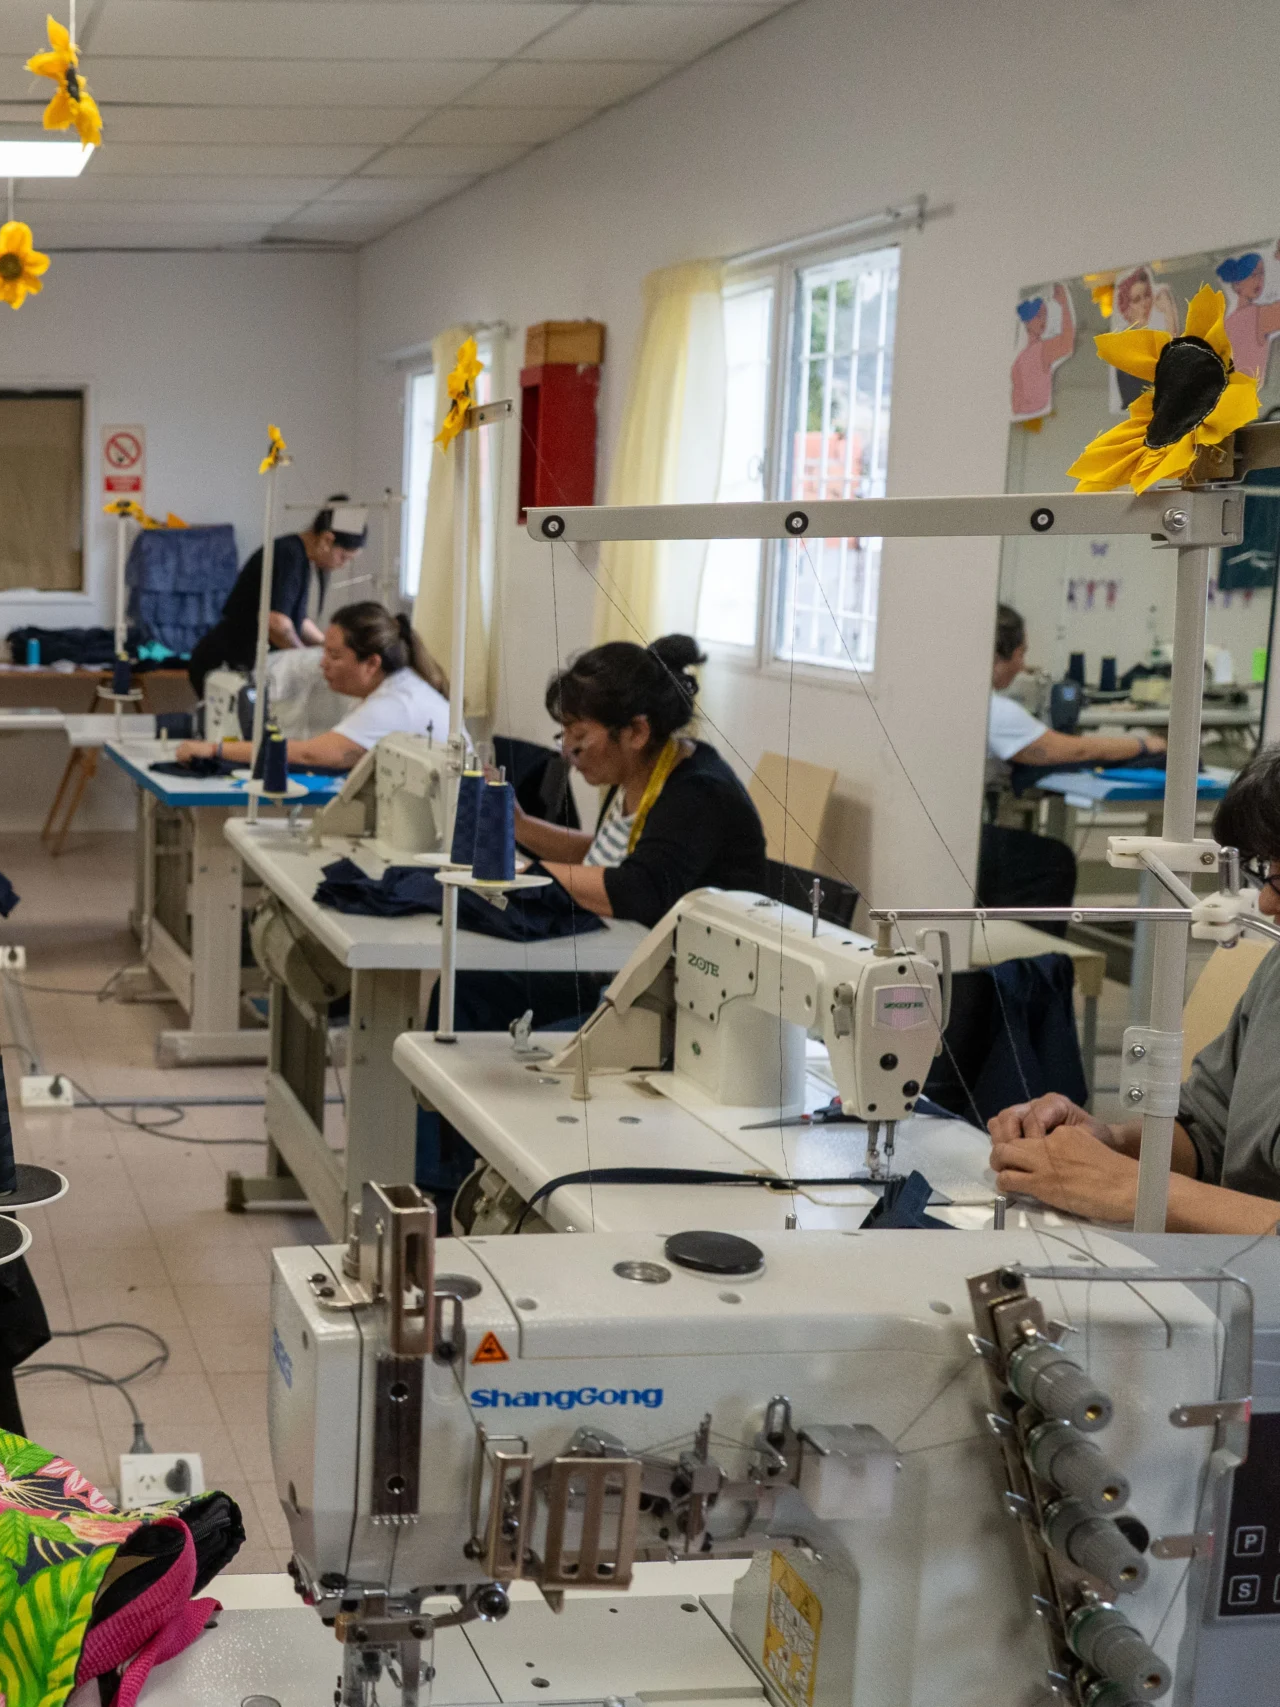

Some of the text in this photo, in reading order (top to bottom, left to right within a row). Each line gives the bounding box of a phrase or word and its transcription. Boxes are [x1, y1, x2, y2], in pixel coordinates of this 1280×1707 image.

[687, 952, 720, 977] ZOJE
[470, 1386, 664, 1411] ShangGong
[1244, 1533, 1258, 1550] P
[1238, 1582, 1251, 1598] S
